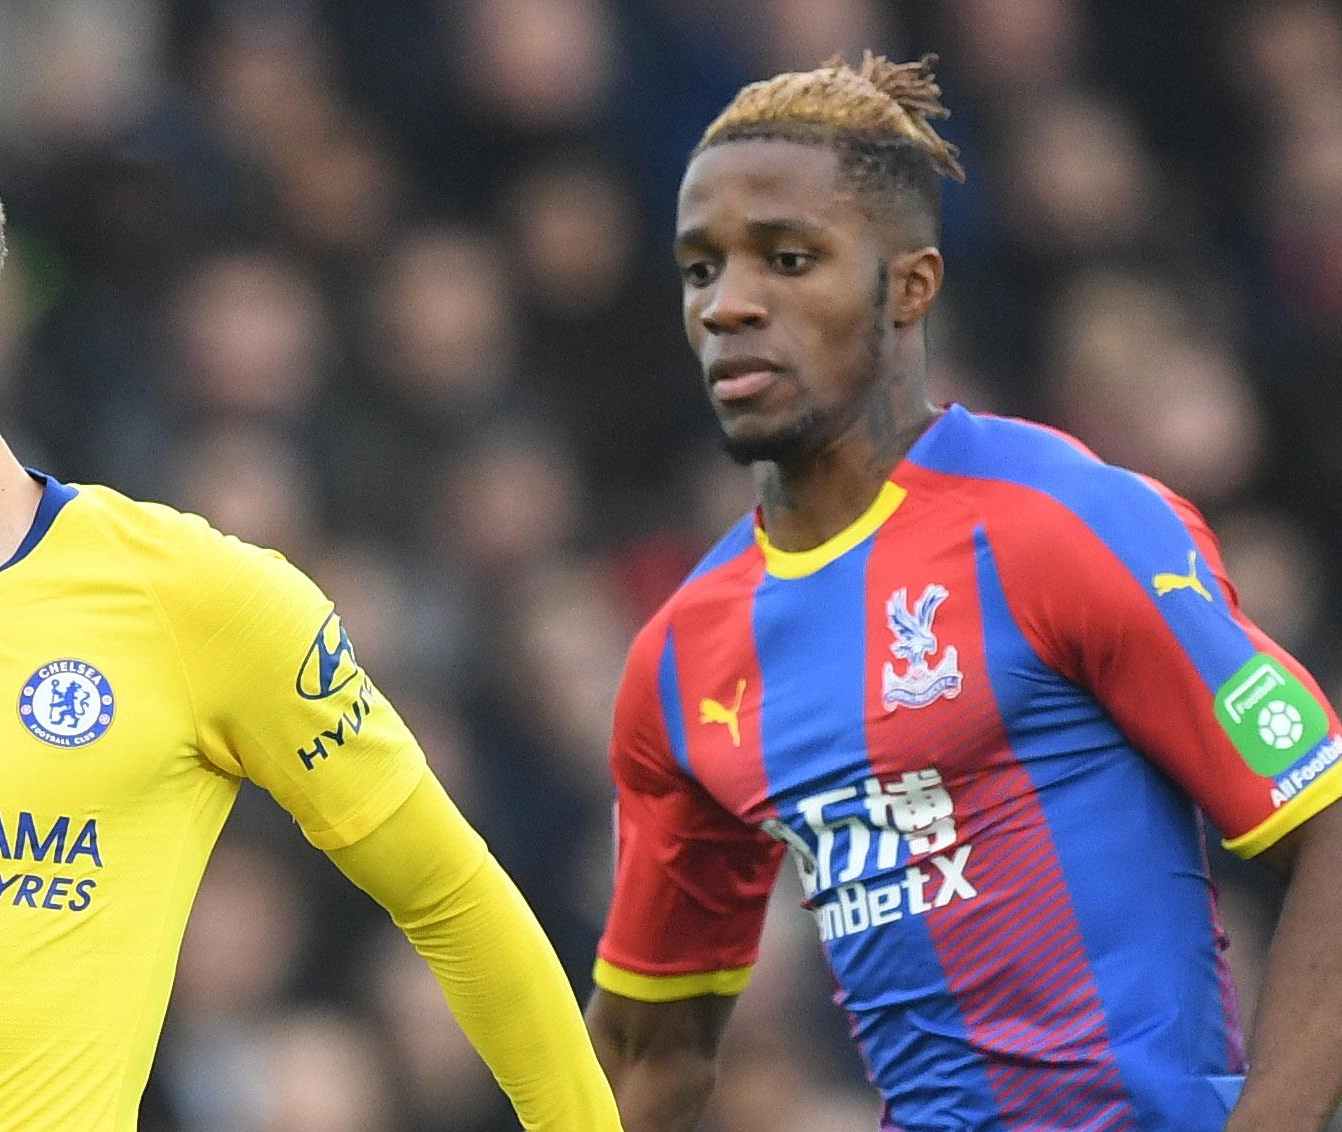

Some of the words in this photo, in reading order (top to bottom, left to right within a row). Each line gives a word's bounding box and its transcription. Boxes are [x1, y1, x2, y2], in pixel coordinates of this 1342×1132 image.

[38, 661, 102, 687] CHELSEA
[30, 723, 71, 746] FOOTBALL
[74, 731, 96, 745] CLUB
[1270, 777, 1297, 809] All
